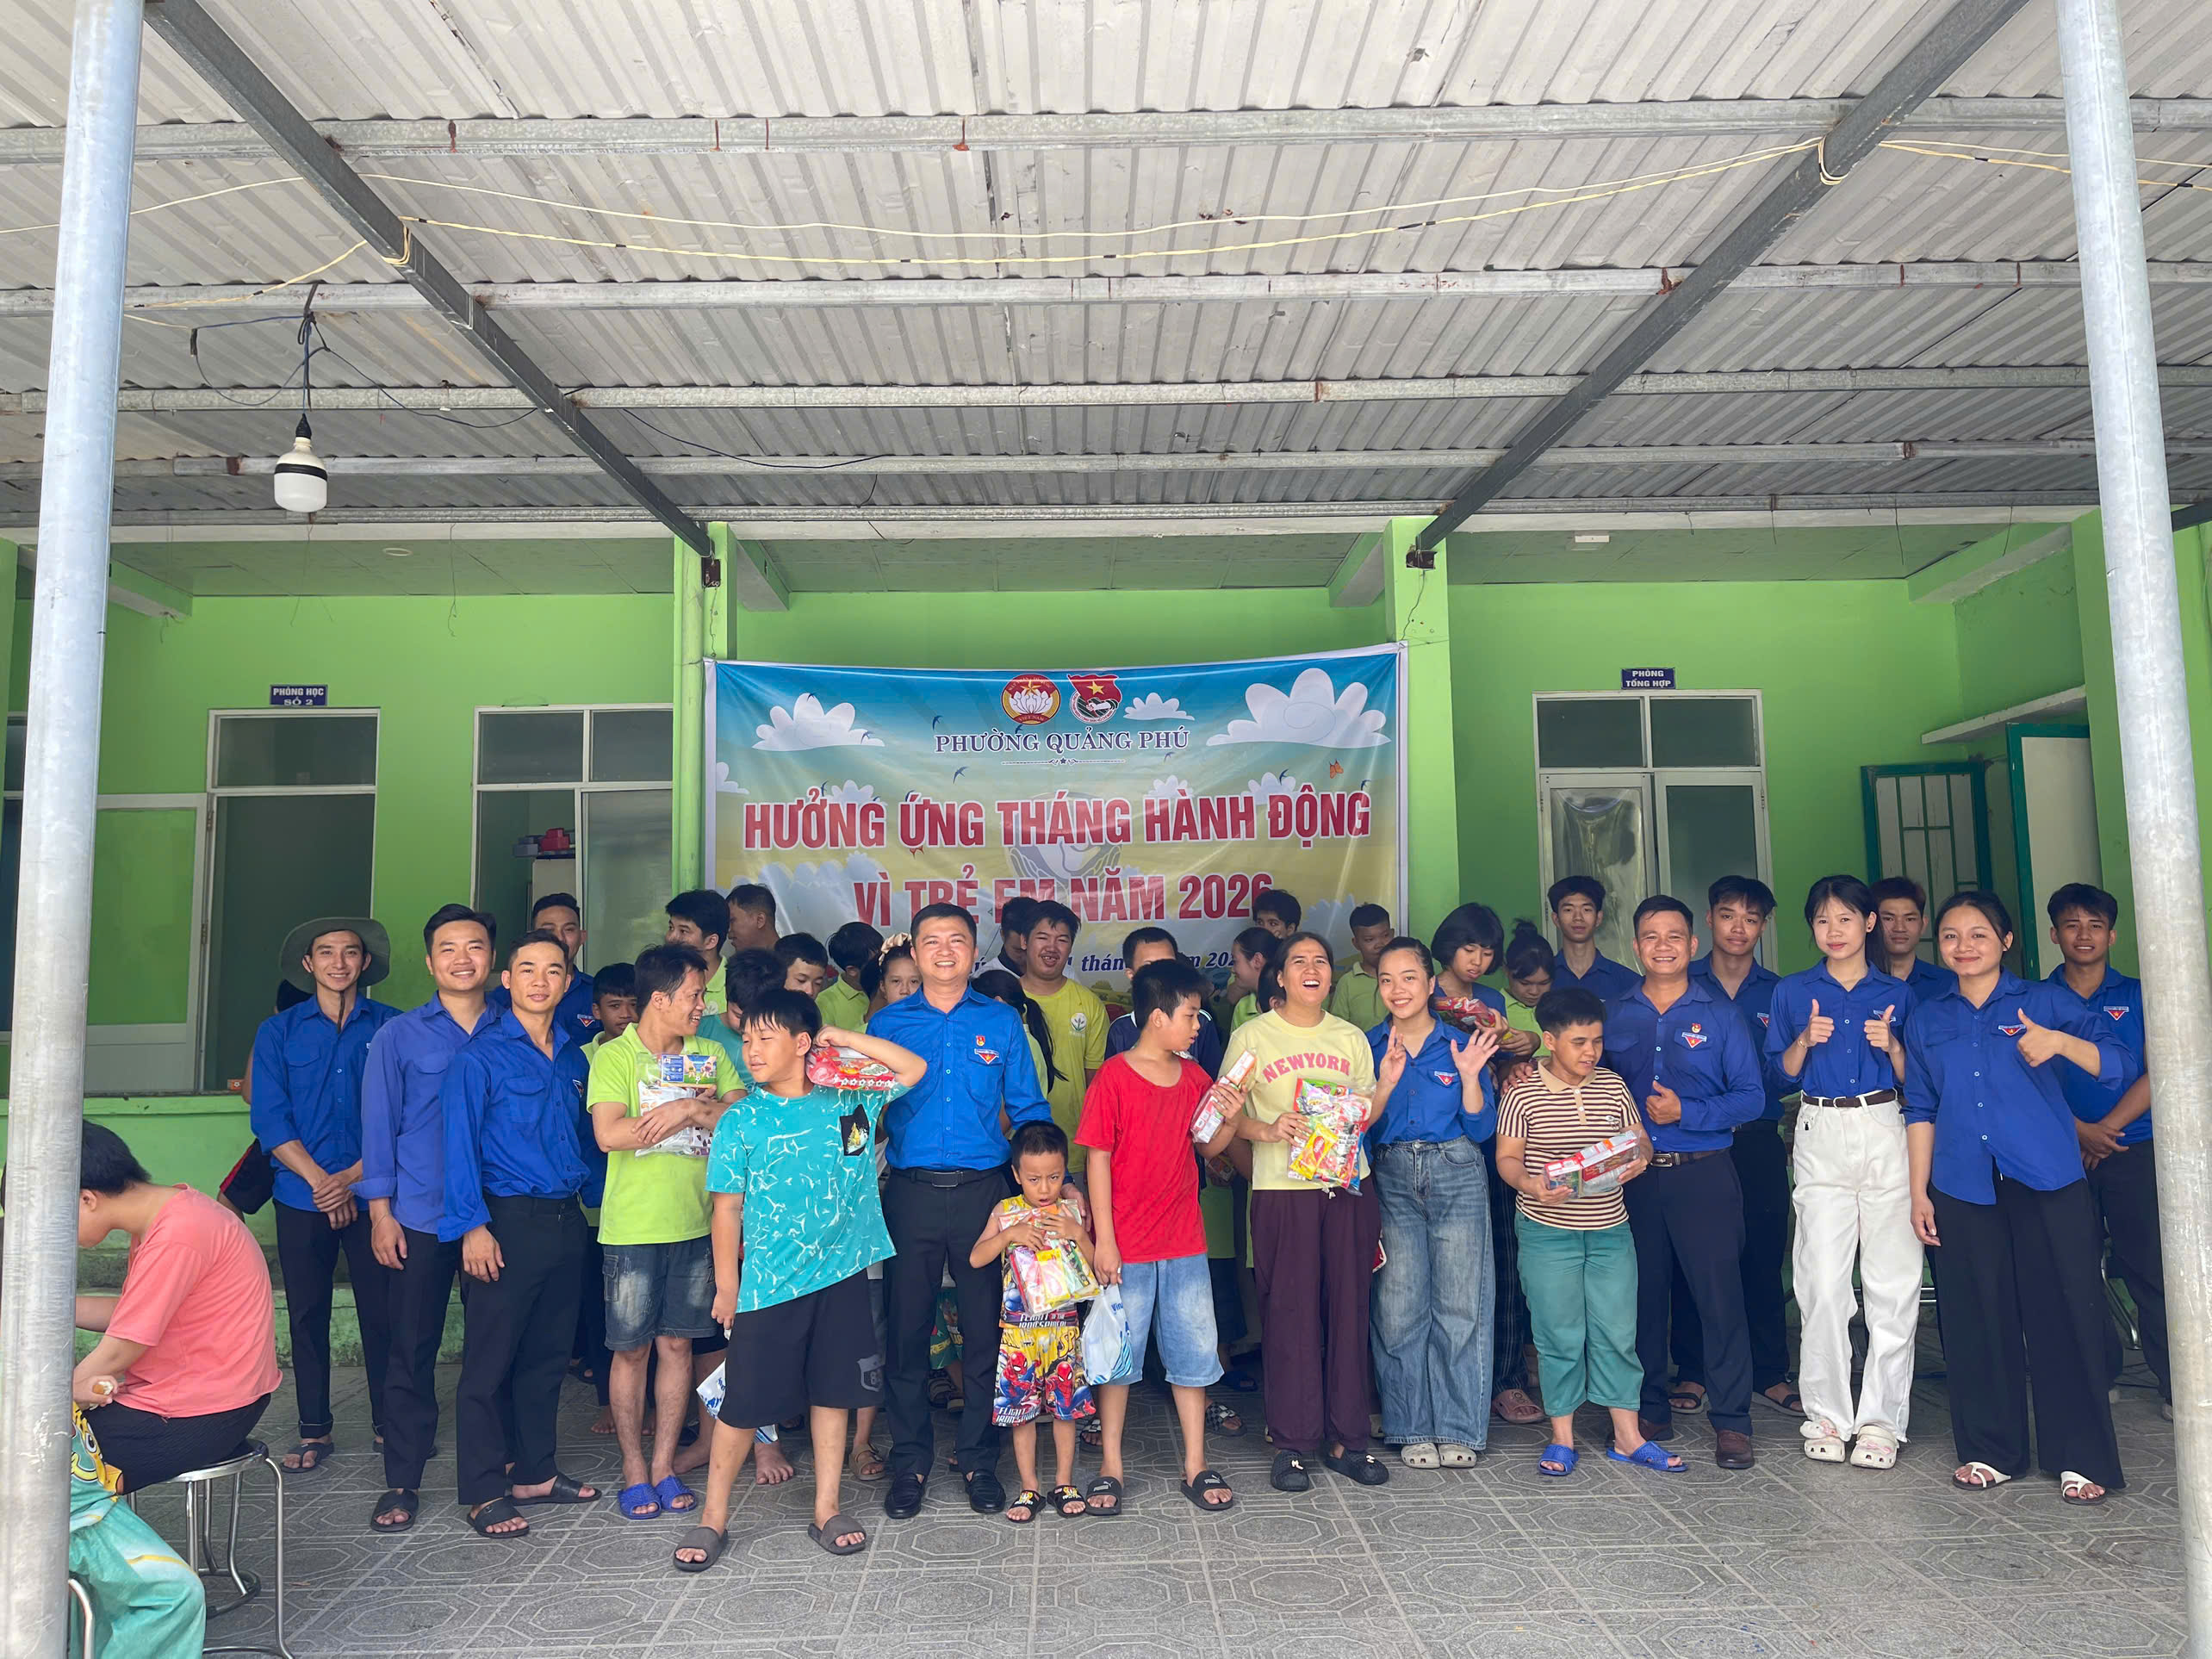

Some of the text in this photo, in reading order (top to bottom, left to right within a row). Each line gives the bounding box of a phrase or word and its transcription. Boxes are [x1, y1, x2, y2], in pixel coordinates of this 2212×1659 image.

[1625, 678, 1671, 688] TỔNG HỢP
[1632, 668, 1664, 677] PHÒNG
[306, 687, 324, 698] HỌC
[935, 726, 1188, 753] PHƯỜNG QUẢNG PHÚ
[744, 784, 1370, 848] HƯỞNG ỨNG THÁNG HÀNH ĐỘNG
[854, 872, 892, 927] VÌ
[904, 865, 979, 924] TRẺ
[1070, 867, 1165, 921] NĂM
[1081, 954, 1124, 972] thán
[1262, 1053, 1351, 1084] NEWYORK
